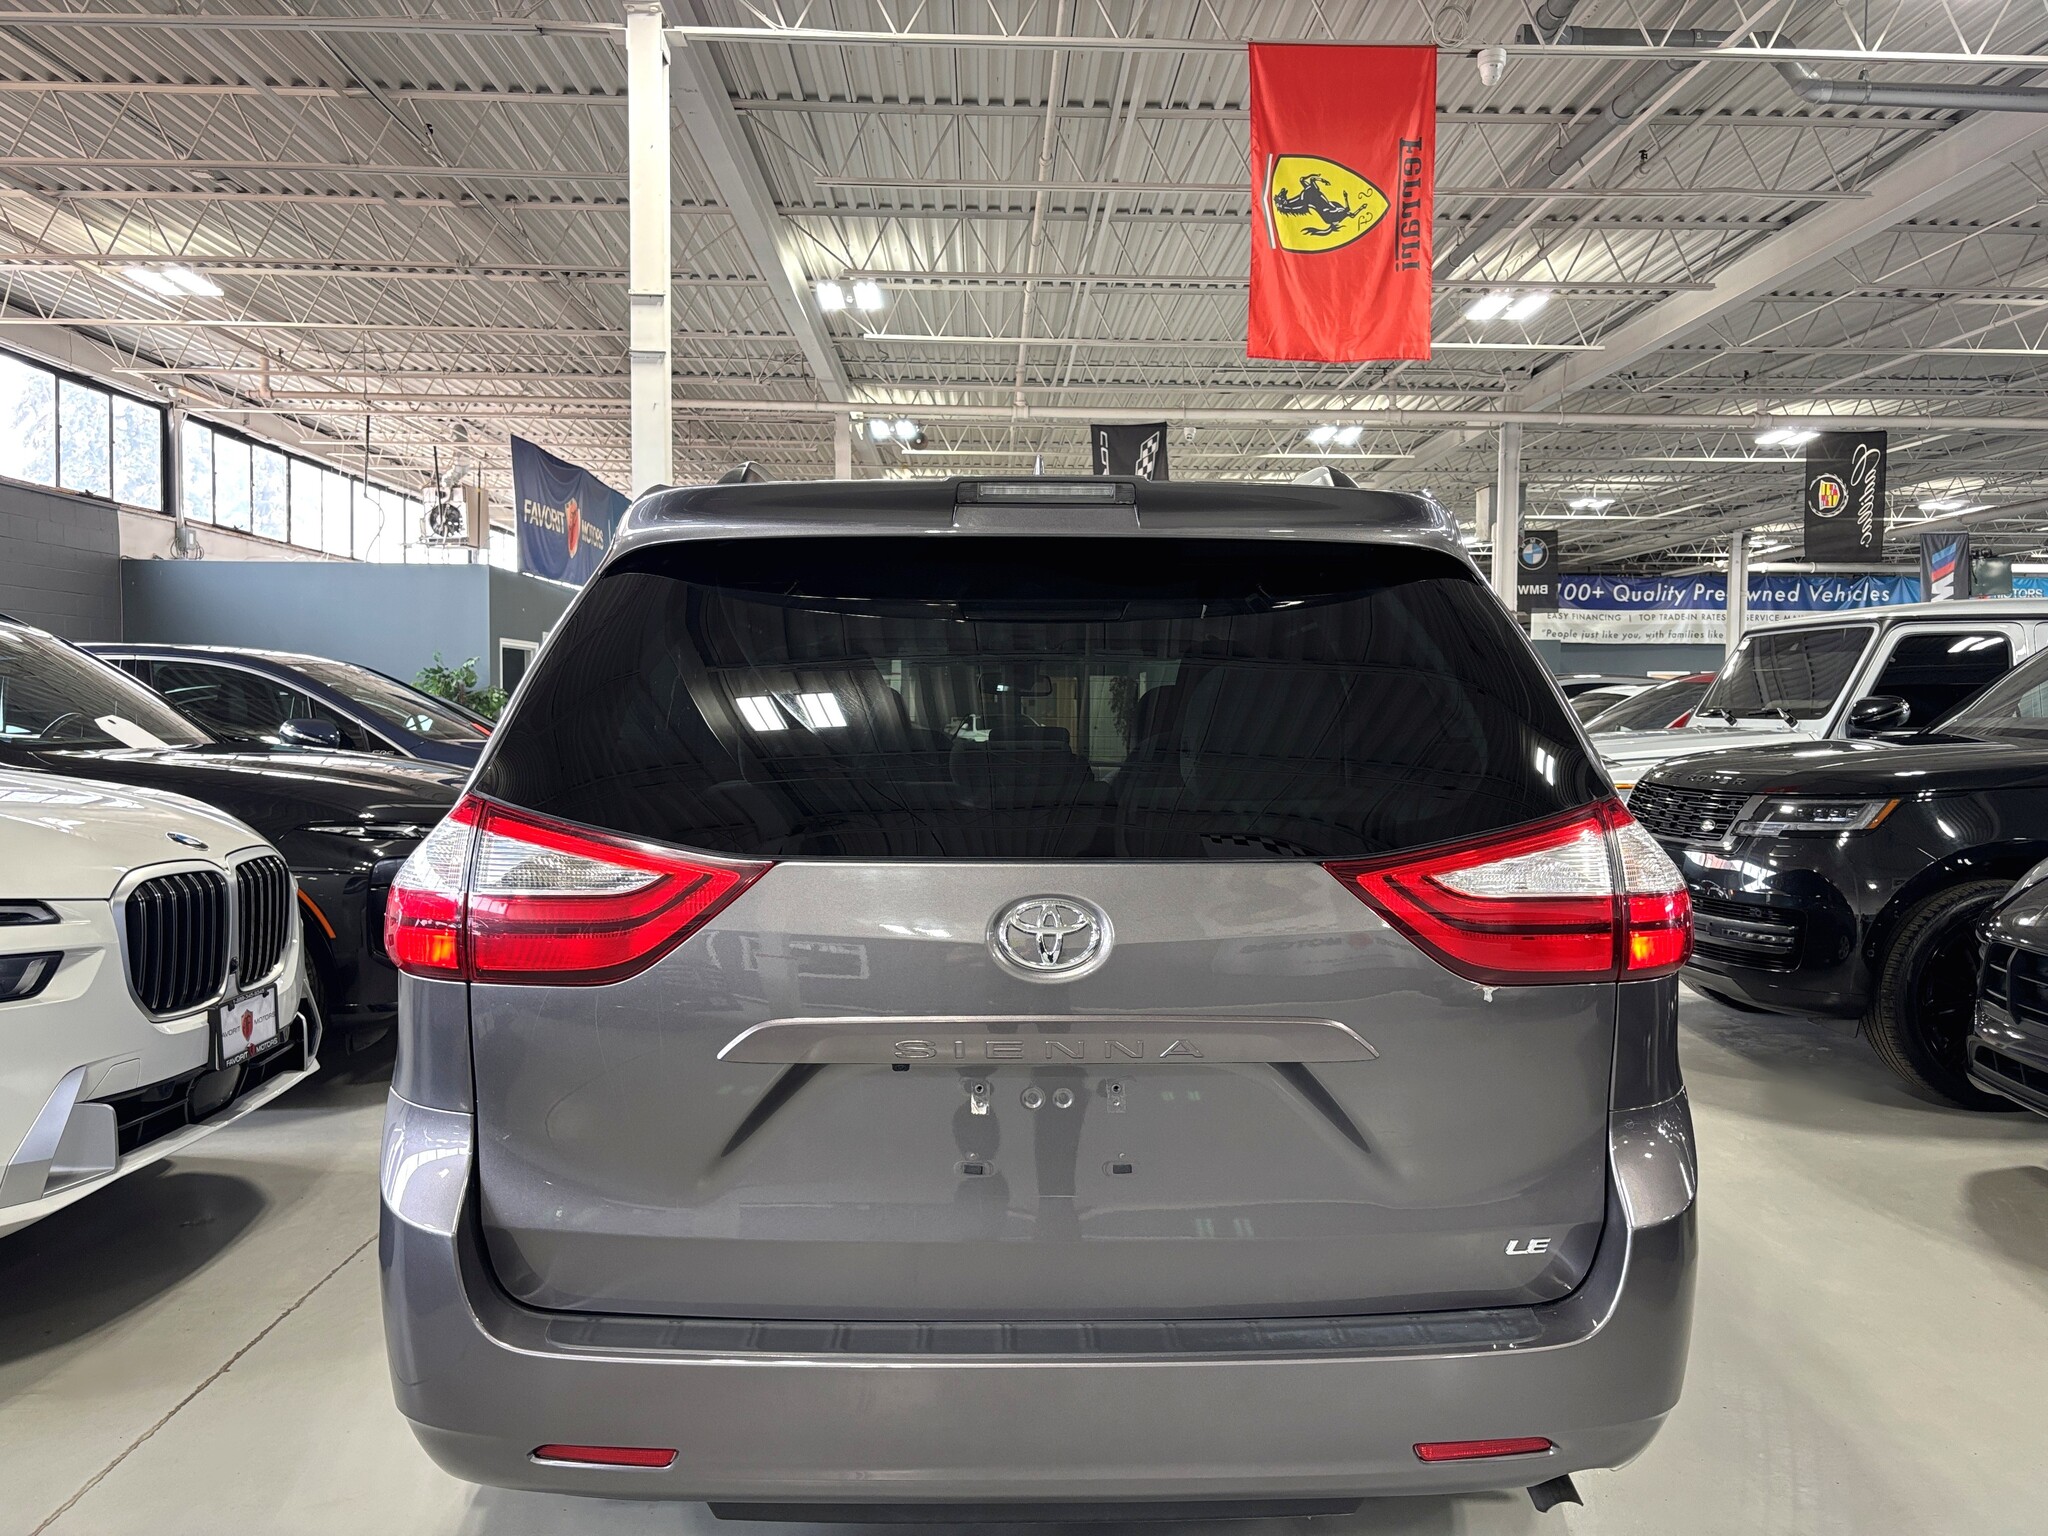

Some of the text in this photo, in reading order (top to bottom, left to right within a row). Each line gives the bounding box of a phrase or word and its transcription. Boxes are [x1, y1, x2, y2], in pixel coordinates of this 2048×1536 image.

[524, 499, 604, 550] FAVORIT MOTORS
[1613, 583, 1686, 606] Quality
[1809, 582, 1890, 602] Vehicles
[1572, 613, 1622, 621] FINANCING
[1660, 613, 1698, 621] TRADE-IN
[1702, 613, 1727, 621] RATES
[1581, 629, 1599, 640] just
[1602, 628, 1619, 639] like
[1645, 630, 1664, 639] with
[1668, 629, 1705, 639] families
[1708, 629, 1724, 639] like
[222, 1011, 275, 1038] AVORIT MOTORS
[226, 1037, 278, 1067] FAVORIT MOTORS
[894, 1039, 1204, 1060] SIENNA
[1504, 1237, 1551, 1256] LE
